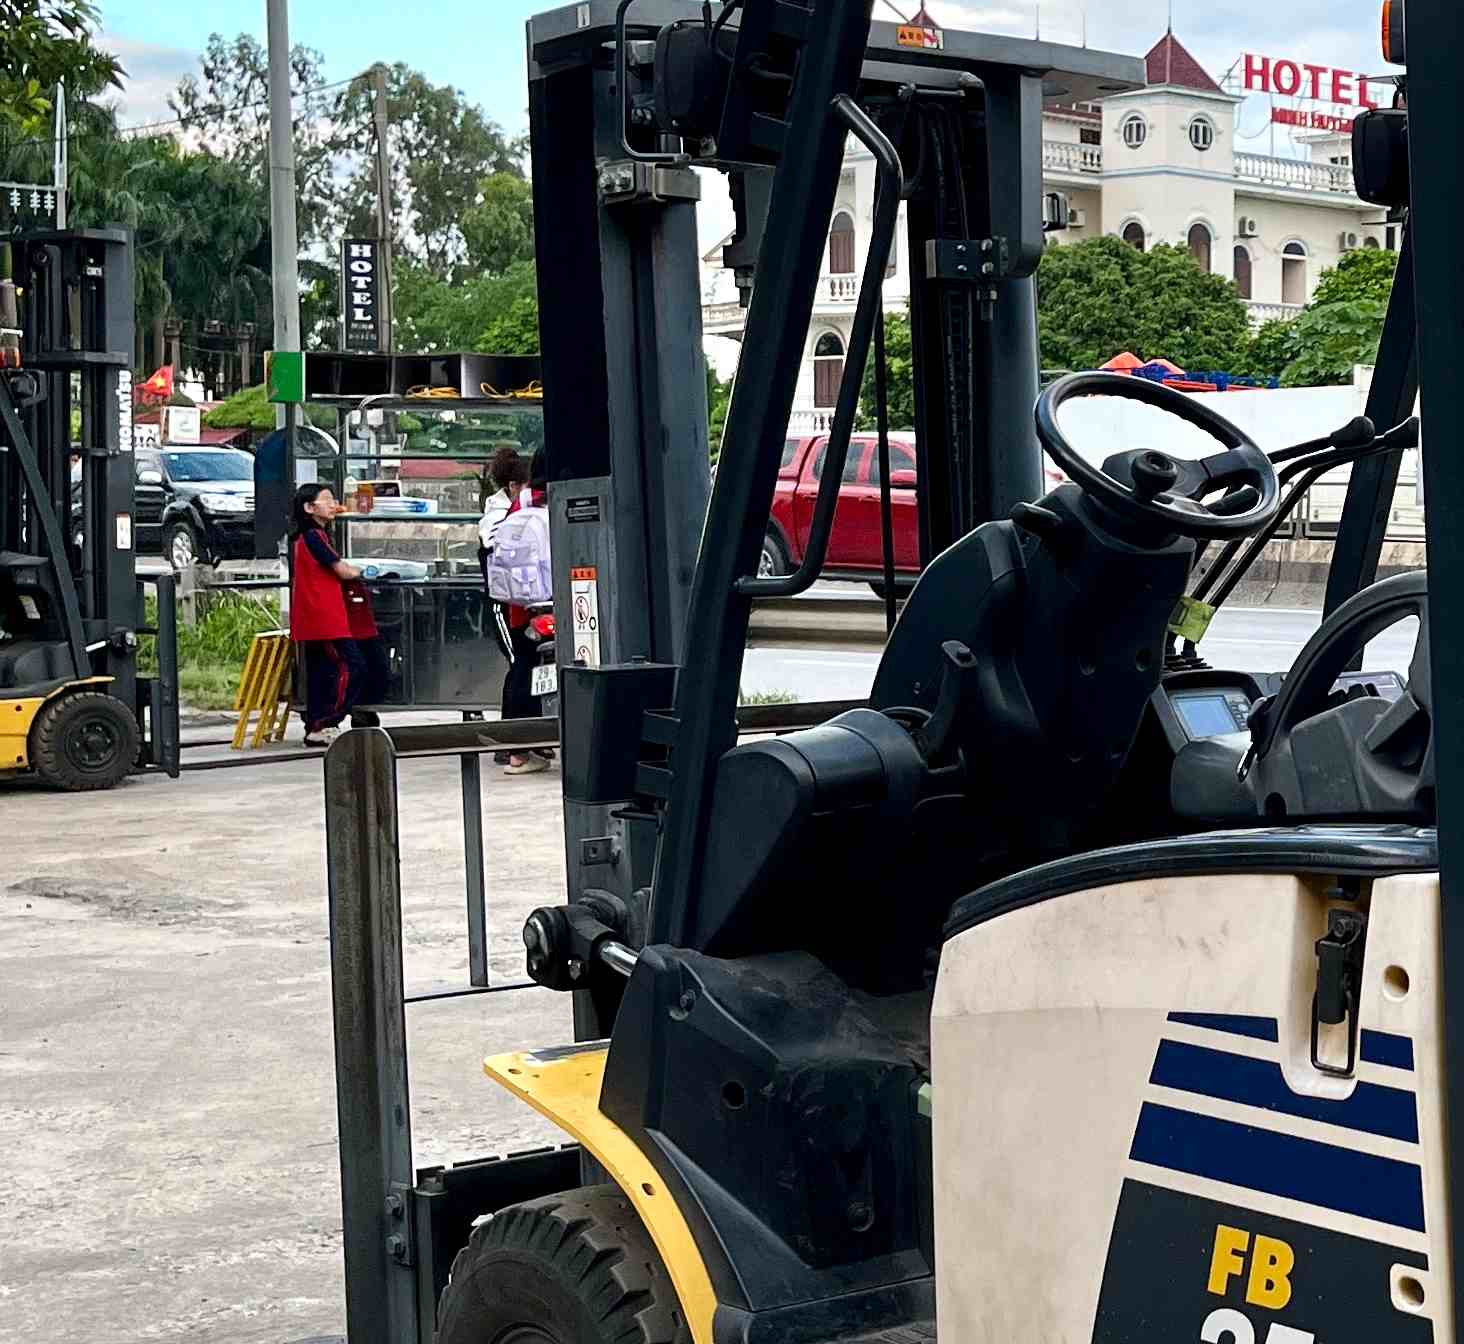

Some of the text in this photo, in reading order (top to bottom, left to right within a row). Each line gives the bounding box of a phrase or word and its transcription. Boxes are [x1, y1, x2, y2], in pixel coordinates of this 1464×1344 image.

[1245, 54, 1377, 110] HOTEL
[350, 244, 373, 321] HOTEL
[1208, 1224, 1295, 1310] FB
